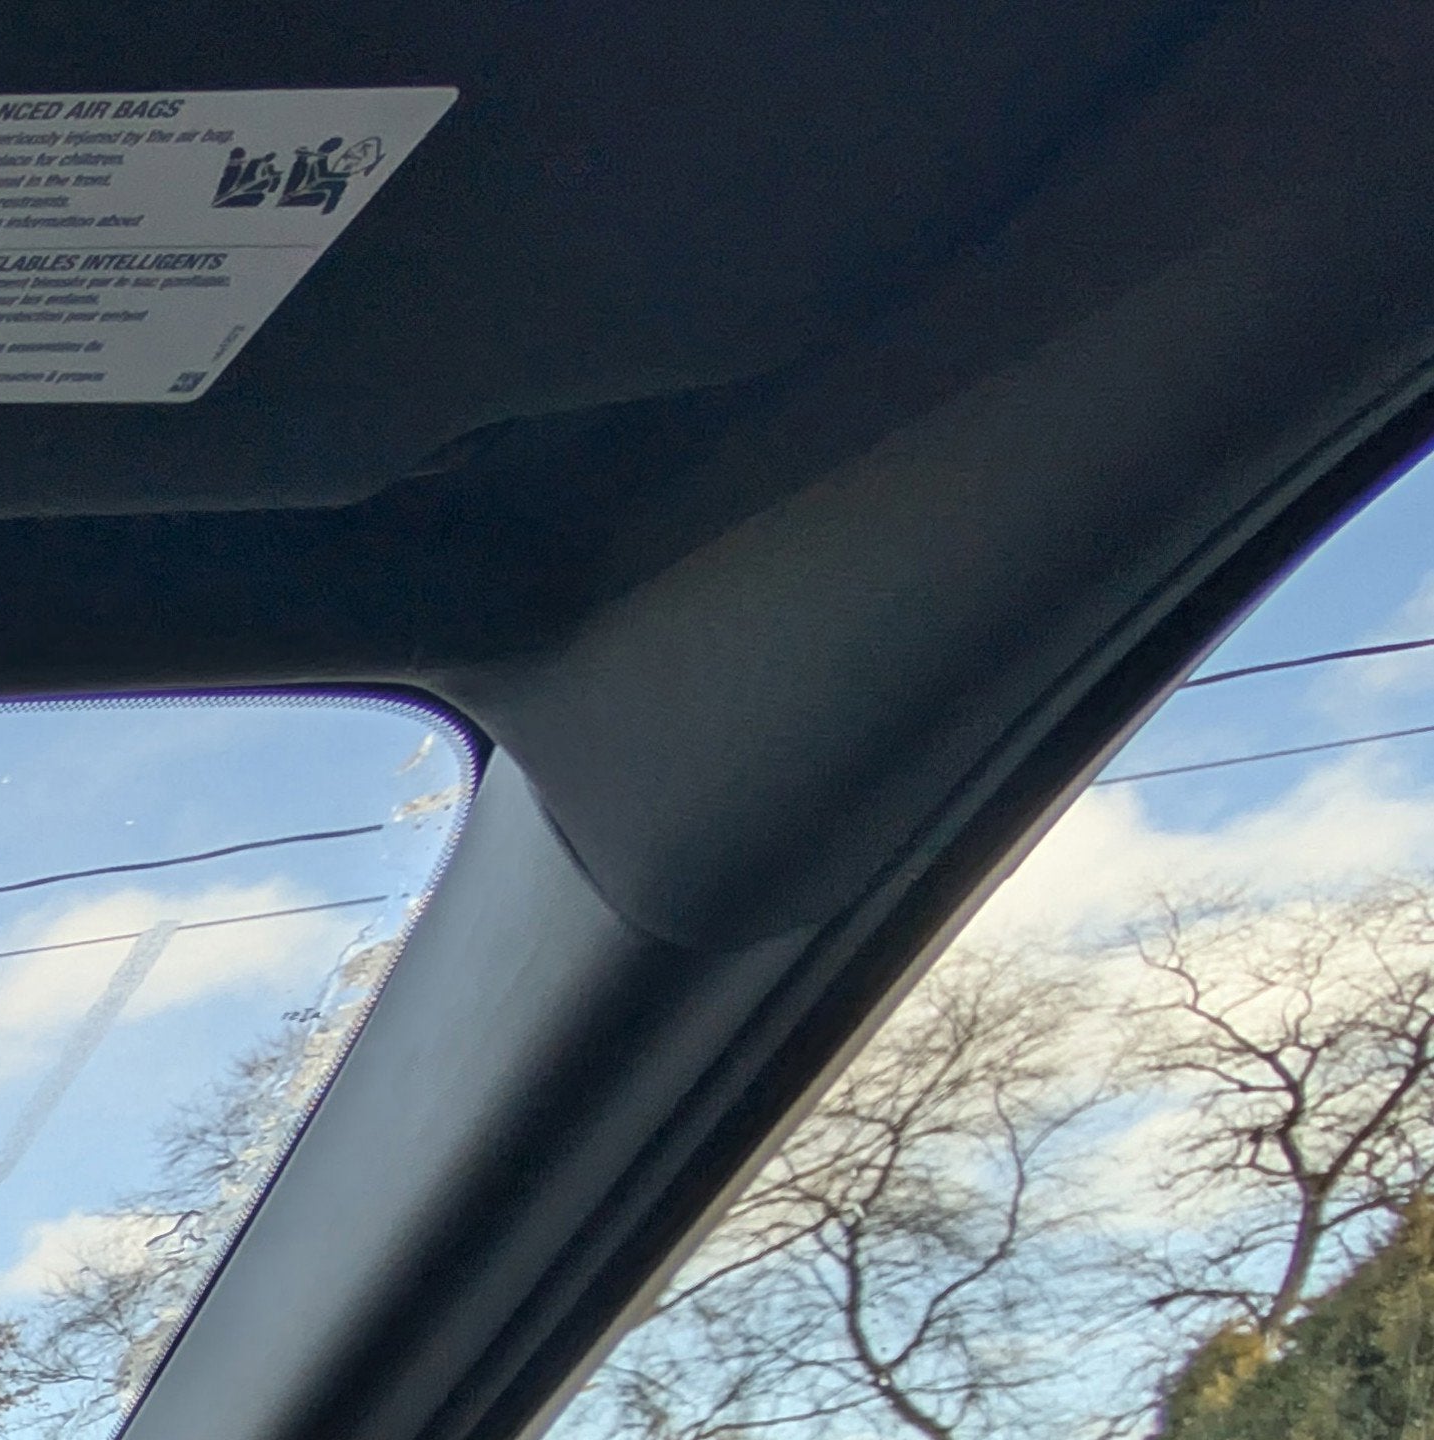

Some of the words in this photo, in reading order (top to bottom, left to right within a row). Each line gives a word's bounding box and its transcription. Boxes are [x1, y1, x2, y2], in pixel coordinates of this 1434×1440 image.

[64, 101, 112, 120] AIR
[111, 99, 185, 119] BAGS
[80, 253, 228, 270] INTELLIGENTS
